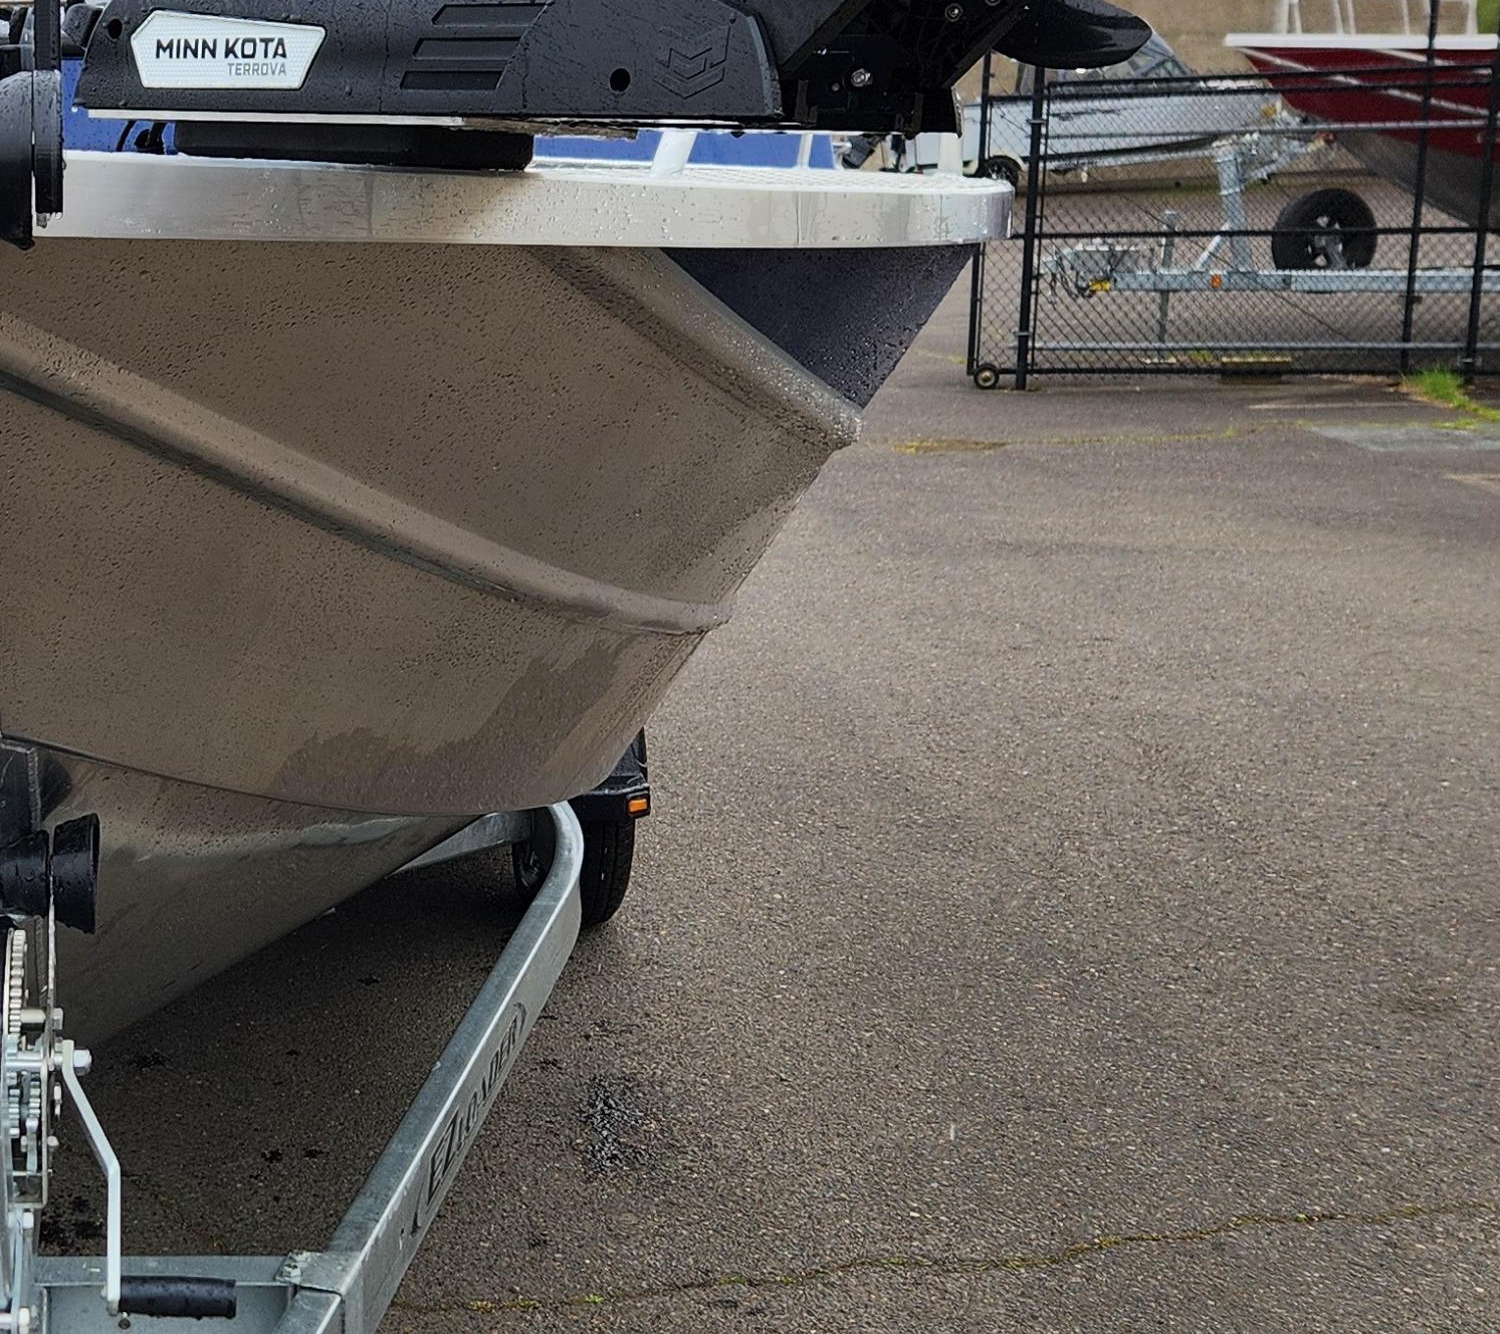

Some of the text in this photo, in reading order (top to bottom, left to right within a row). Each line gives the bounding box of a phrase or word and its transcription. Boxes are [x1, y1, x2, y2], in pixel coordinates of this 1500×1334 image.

[155, 37, 288, 60] MINN KOTA
[227, 62, 287, 76] TERROVA
